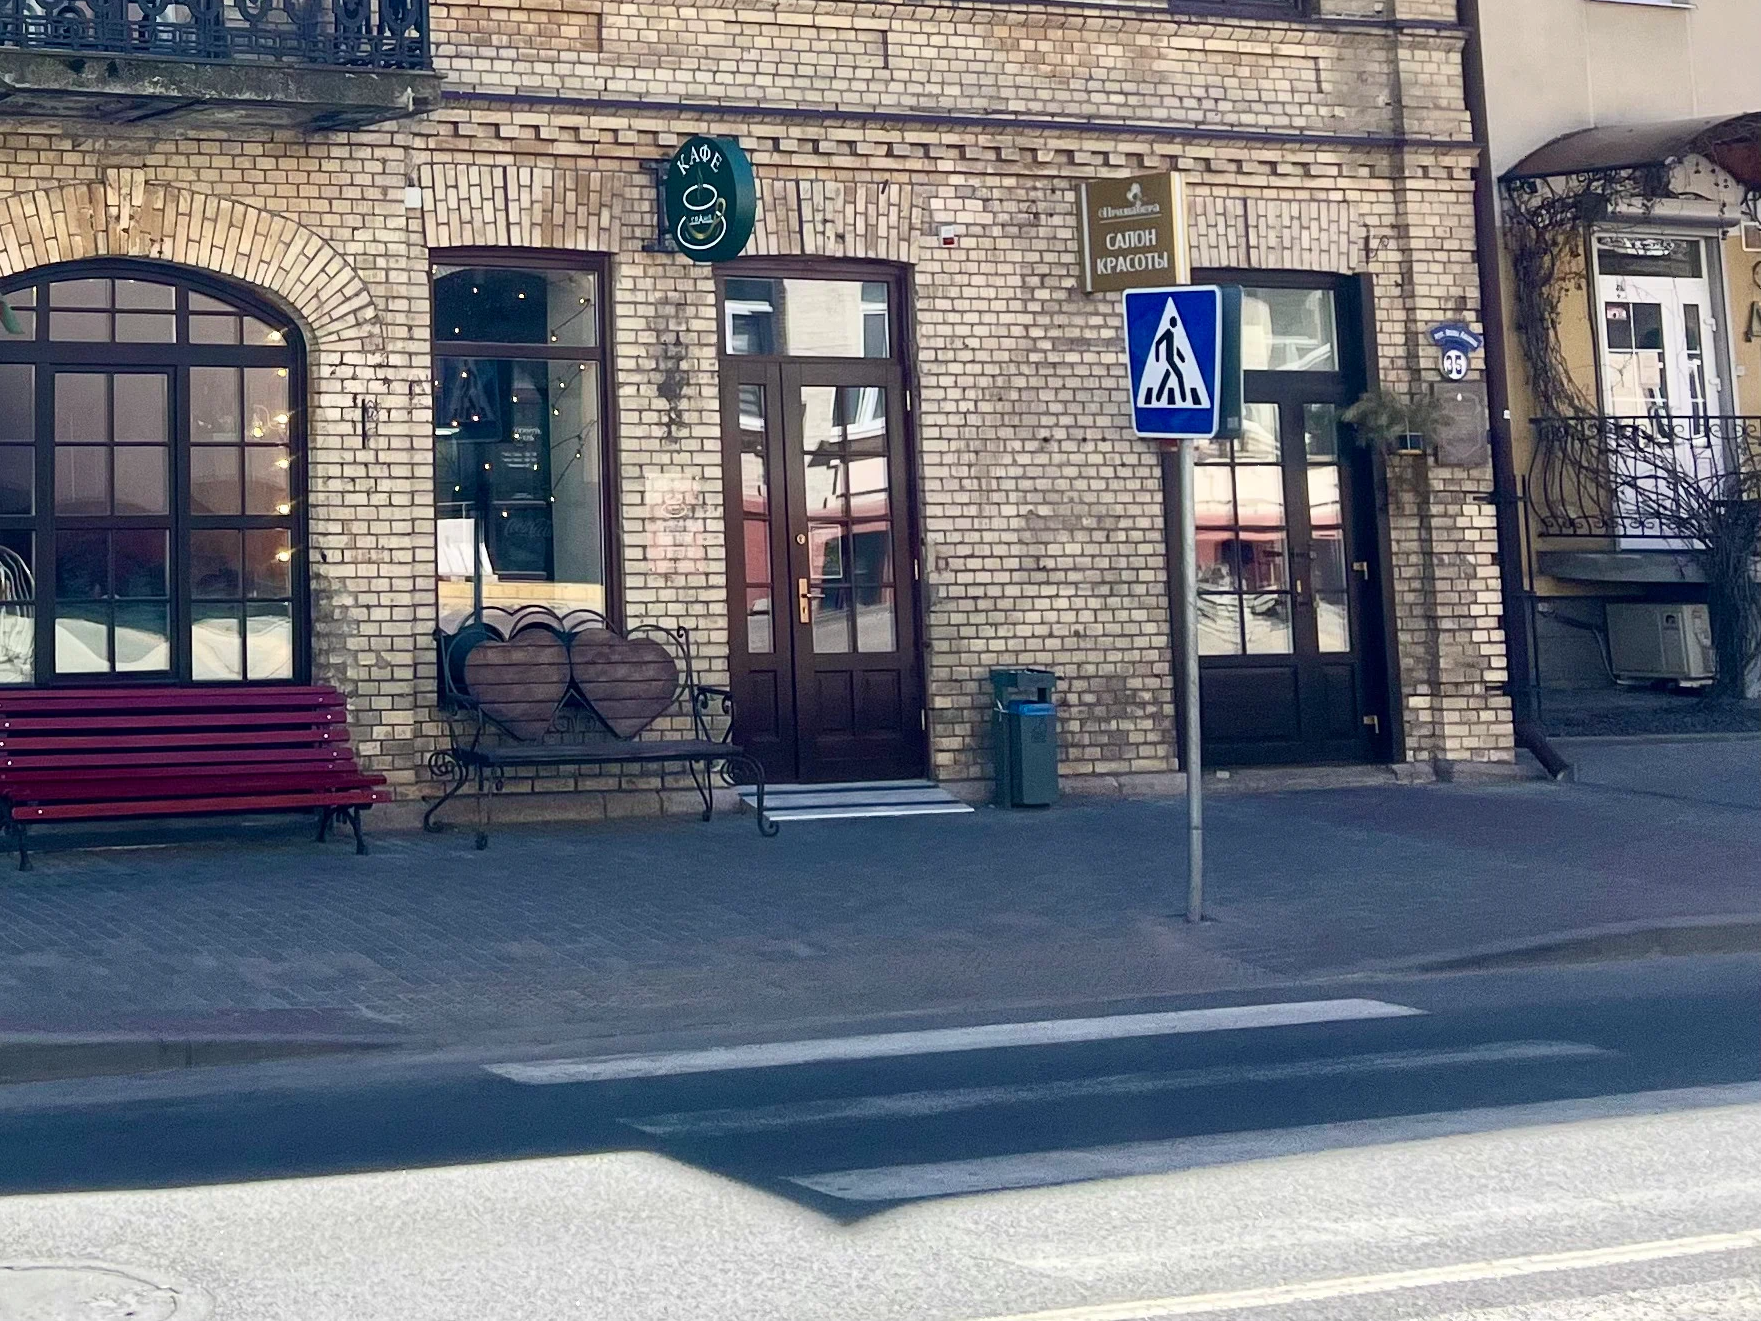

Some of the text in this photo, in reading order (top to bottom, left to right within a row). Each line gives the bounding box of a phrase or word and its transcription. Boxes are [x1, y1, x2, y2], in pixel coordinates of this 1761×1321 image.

[677, 144, 722, 176] КАФЕ
[1106, 228, 1157, 250] САЛОН
[1096, 252, 1168, 275] КРАСОТЫ
[1445, 355, 1462, 375] 35
